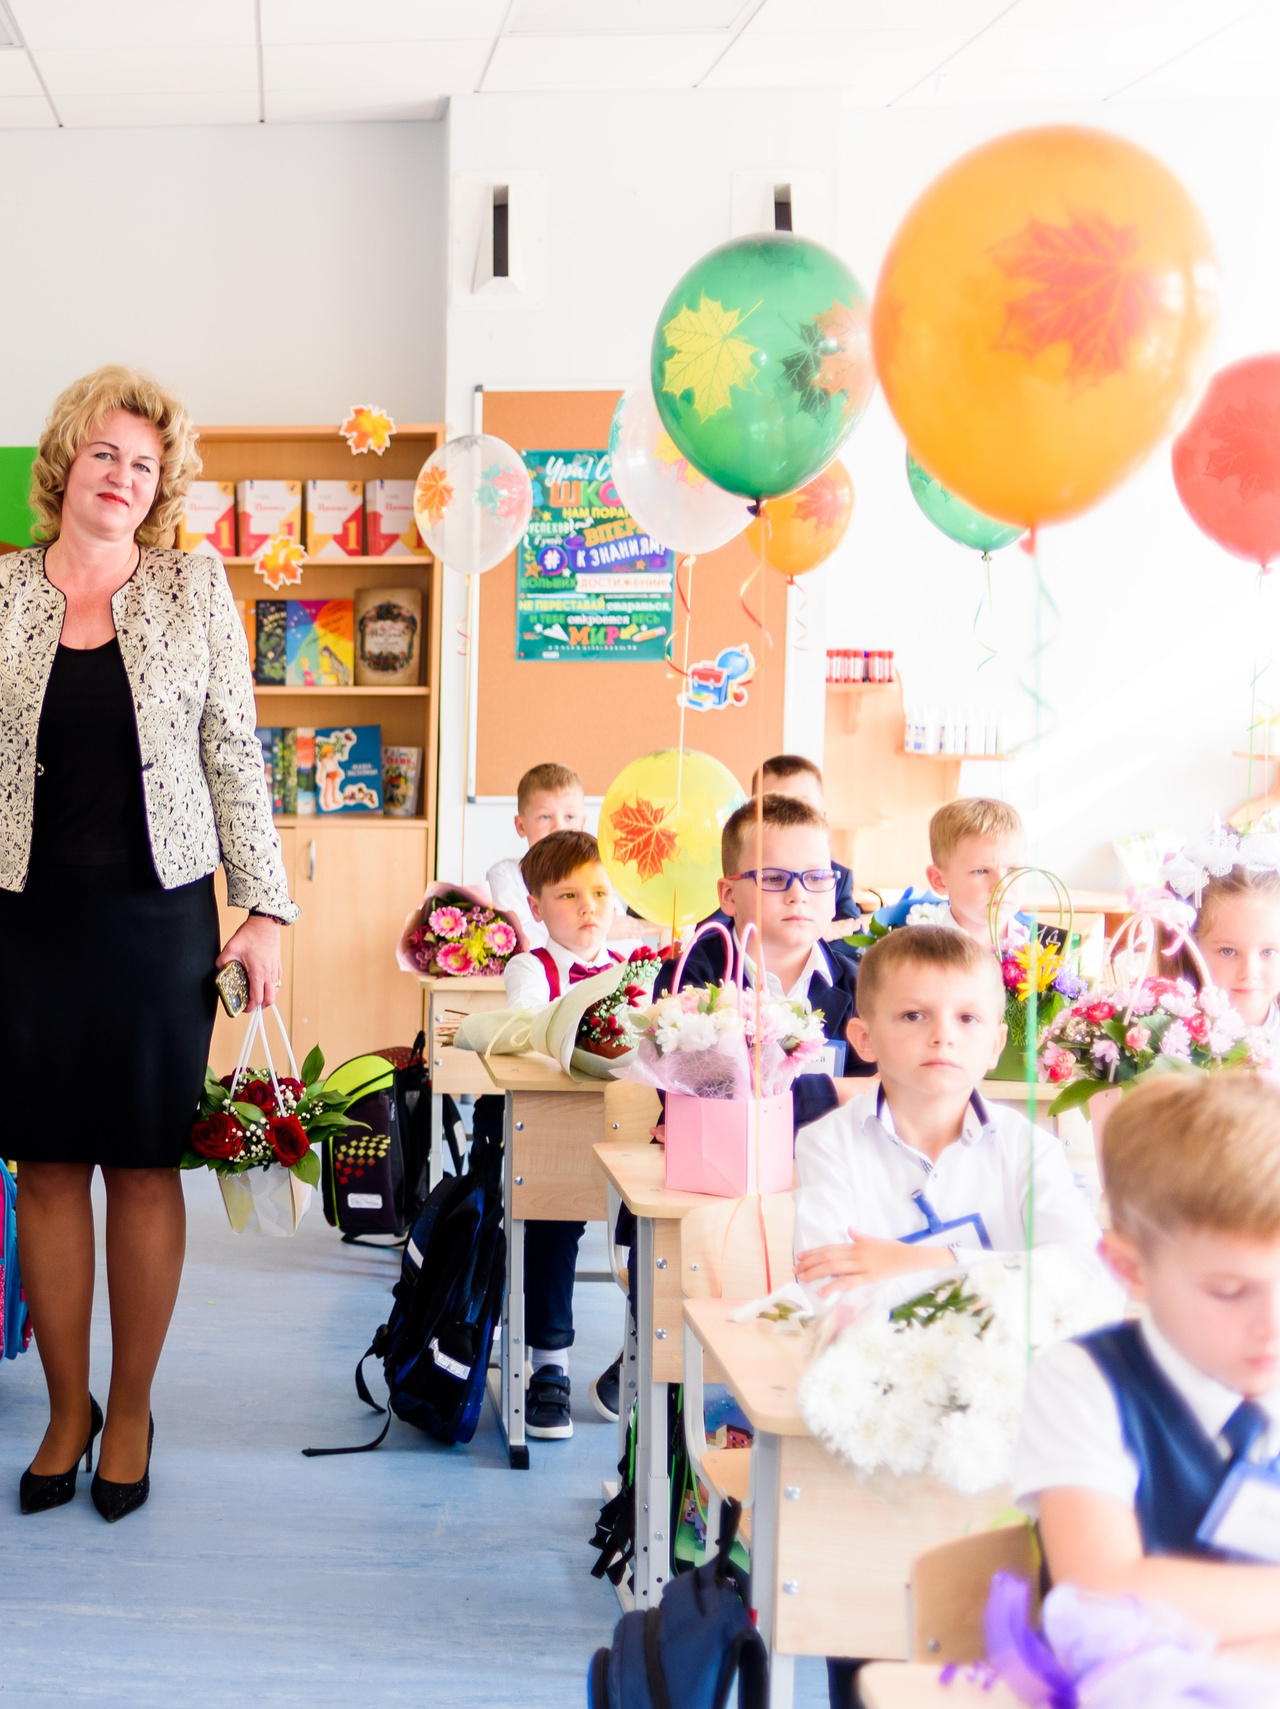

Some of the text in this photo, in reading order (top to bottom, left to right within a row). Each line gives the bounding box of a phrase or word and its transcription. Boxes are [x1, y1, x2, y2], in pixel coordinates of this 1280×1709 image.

[544, 456, 595, 488] Ура!
[549, 480, 623, 508] ШКО
[562, 507, 590, 519] НАМ
[346, 520, 360, 549] 1
[583, 517, 646, 548] ВПЕР
[576, 537, 666, 568] К ЗНАНИЯМ!
[519, 600, 534, 612] НЕ
[535, 597, 606, 612] ПЕРЕСТАВАЙ
[568, 626, 620, 645] МИР
